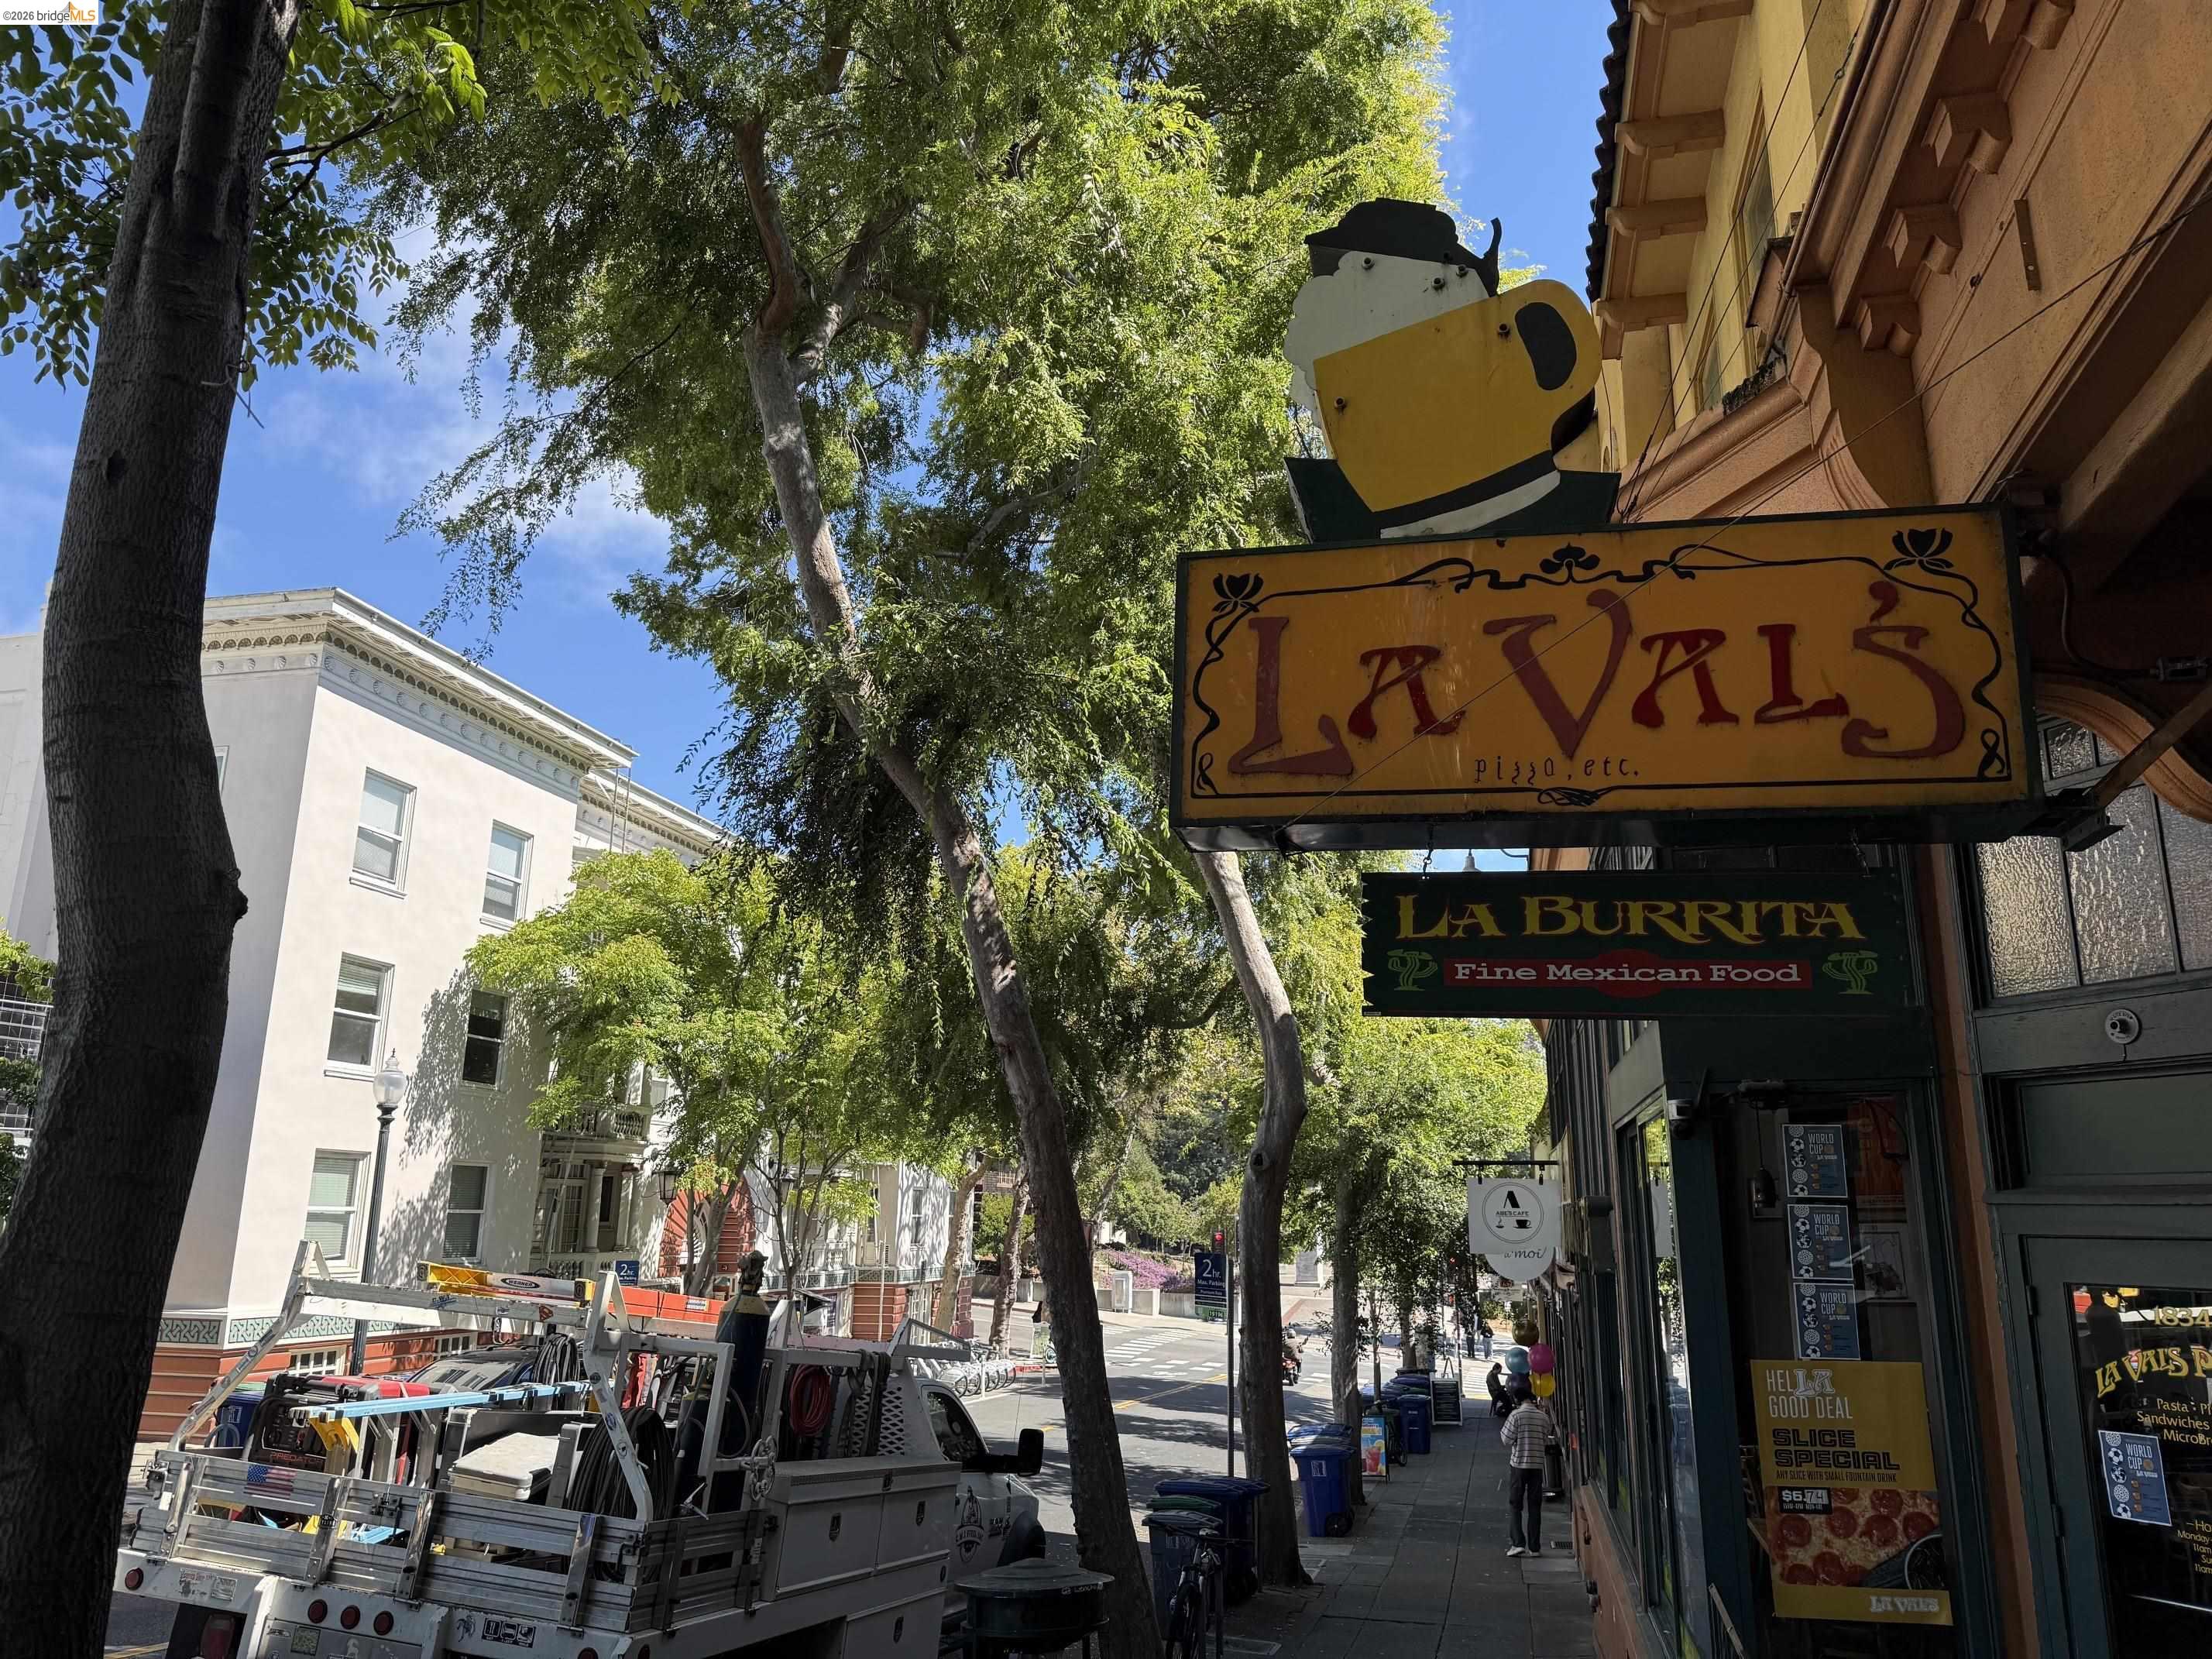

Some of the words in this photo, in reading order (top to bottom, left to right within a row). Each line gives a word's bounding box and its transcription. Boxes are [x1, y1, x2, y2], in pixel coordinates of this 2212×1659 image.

[1584, 756, 1640, 777] etc.
[1395, 895, 1507, 940] LA
[1520, 895, 1867, 945] BURRITA
[1455, 963, 1537, 981] Fine
[1546, 964, 1702, 982] Mexican
[1709, 965, 1802, 983] Food
[1808, 1133, 1834, 1144] WORLD
[1808, 1144, 1823, 1155] CUP
[1813, 1214, 1840, 1224] WORLD
[1815, 1224, 1829, 1235] CUP
[620, 1263, 627, 1276] 2
[1202, 1259, 1212, 1277] 2
[1212, 1269, 1221, 1278] hr.
[1208, 1279, 1225, 1288] Parking
[1820, 1292, 1847, 1304] WORLD
[1821, 1304, 1836, 1314] CUP
[2155, 1305, 2212, 1328] 1834
[2094, 1361, 2122, 1400] LA
[1768, 1395, 1809, 1419] GOOD
[1815, 1396, 1853, 1419] DEAL
[2156, 1398, 2189, 1413] Pasta
[2137, 1411, 2210, 1431] Sandwiches
[1772, 1428, 1856, 1448] SLICE
[2125, 1443, 2153, 1458] WORLD
[1774, 1448, 1901, 1471] SPECIAL
[2128, 1456, 2142, 1470] CUP
[1777, 1469, 1789, 1480] ANY
[1789, 1470, 1806, 1481] SLICE
[1808, 1471, 1823, 1481] WITH
[1825, 1472, 1845, 1482] SMALL
[1846, 1472, 1876, 1482] FOUNTAIN
[1877, 1472, 1897, 1482] DRINK
